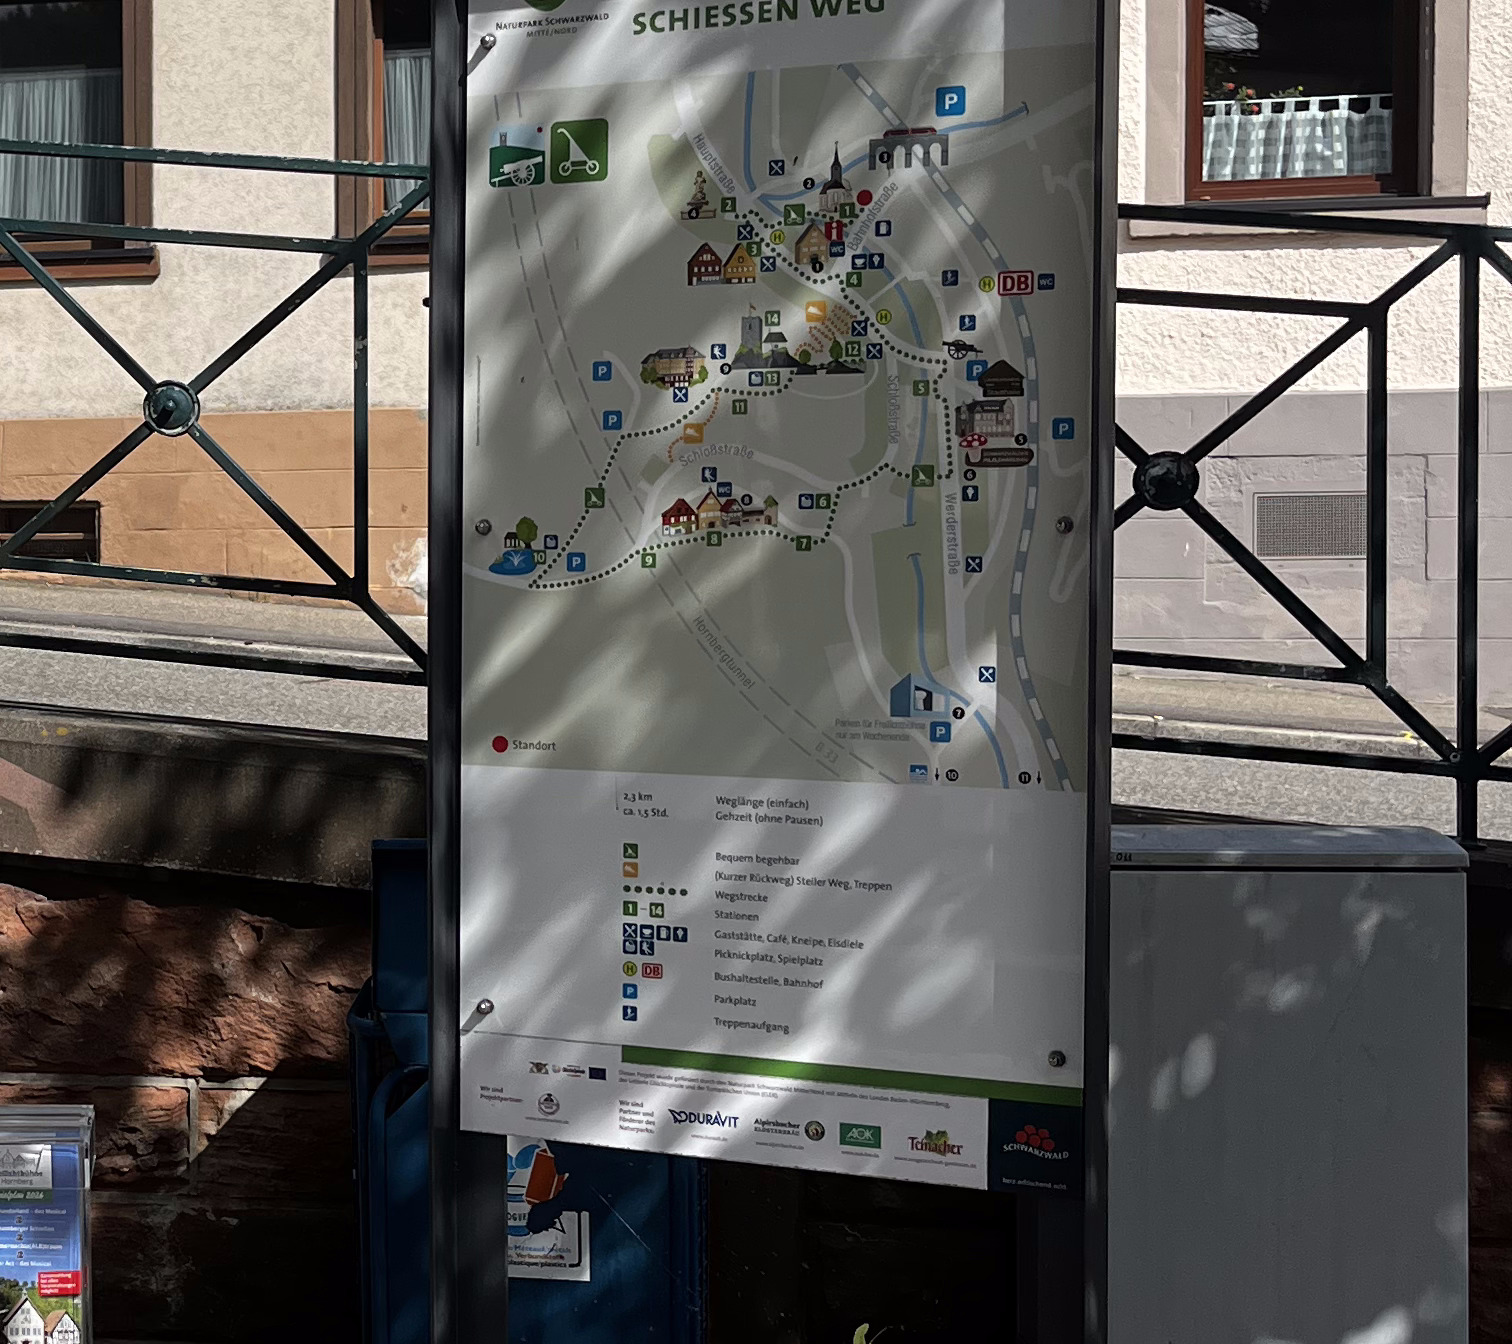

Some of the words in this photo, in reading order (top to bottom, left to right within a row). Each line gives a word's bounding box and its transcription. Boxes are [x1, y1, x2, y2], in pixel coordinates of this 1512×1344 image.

[495, 19, 543, 31] NATURPARK
[545, 12, 609, 26] SCHWARZWALD
[692, 132, 736, 195] Hauptstraße
[847, 181, 899, 251] Bahnhofstraße
[888, 375, 901, 444] Schloßstraße
[679, 443, 754, 467] Schloßstraße
[945, 492, 961, 575] Werderstraße
[693, 615, 756, 690] Hornbergtunnel
[512, 739, 557, 751] Standort
[638, 791, 653, 802] km
[715, 795, 764, 809] Weglänge
[766, 797, 809, 811] (einfach)
[651, 807, 669, 818] Std.
[715, 811, 752, 823] Gehzeit
[754, 812, 783, 825] (ohne
[785, 814, 824, 827] Pausen)
[715, 852, 753, 866] Bequem
[755, 853, 800, 867] begehbar
[714, 871, 747, 883] (Kurzer
[749, 872, 794, 887] Rückweg)
[796, 875, 826, 888] Steiler
[854, 879, 892, 893] Treppen
[714, 890, 768, 903] Wegstrecke
[714, 909, 759, 921] Stationen
[714, 929, 765, 944] Gaststätte,
[766, 933, 790, 945] Café,
[791, 935, 826, 949] Kneipe,
[827, 937, 864, 950] Eisdiele
[714, 949, 776, 964] Picknickplatz,
[778, 954, 823, 967] Spielplatz
[714, 972, 782, 987] Bushaltestelle,
[783, 976, 823, 989] Bahnhof
[714, 994, 757, 1008] Parkplatz
[714, 1016, 790, 1035] Treppenaufgang
[688, 1111, 739, 1129] DURAVIT
[845, 1127, 874, 1141] AOK
[1, 1178, 34, 1186] Hornberg
